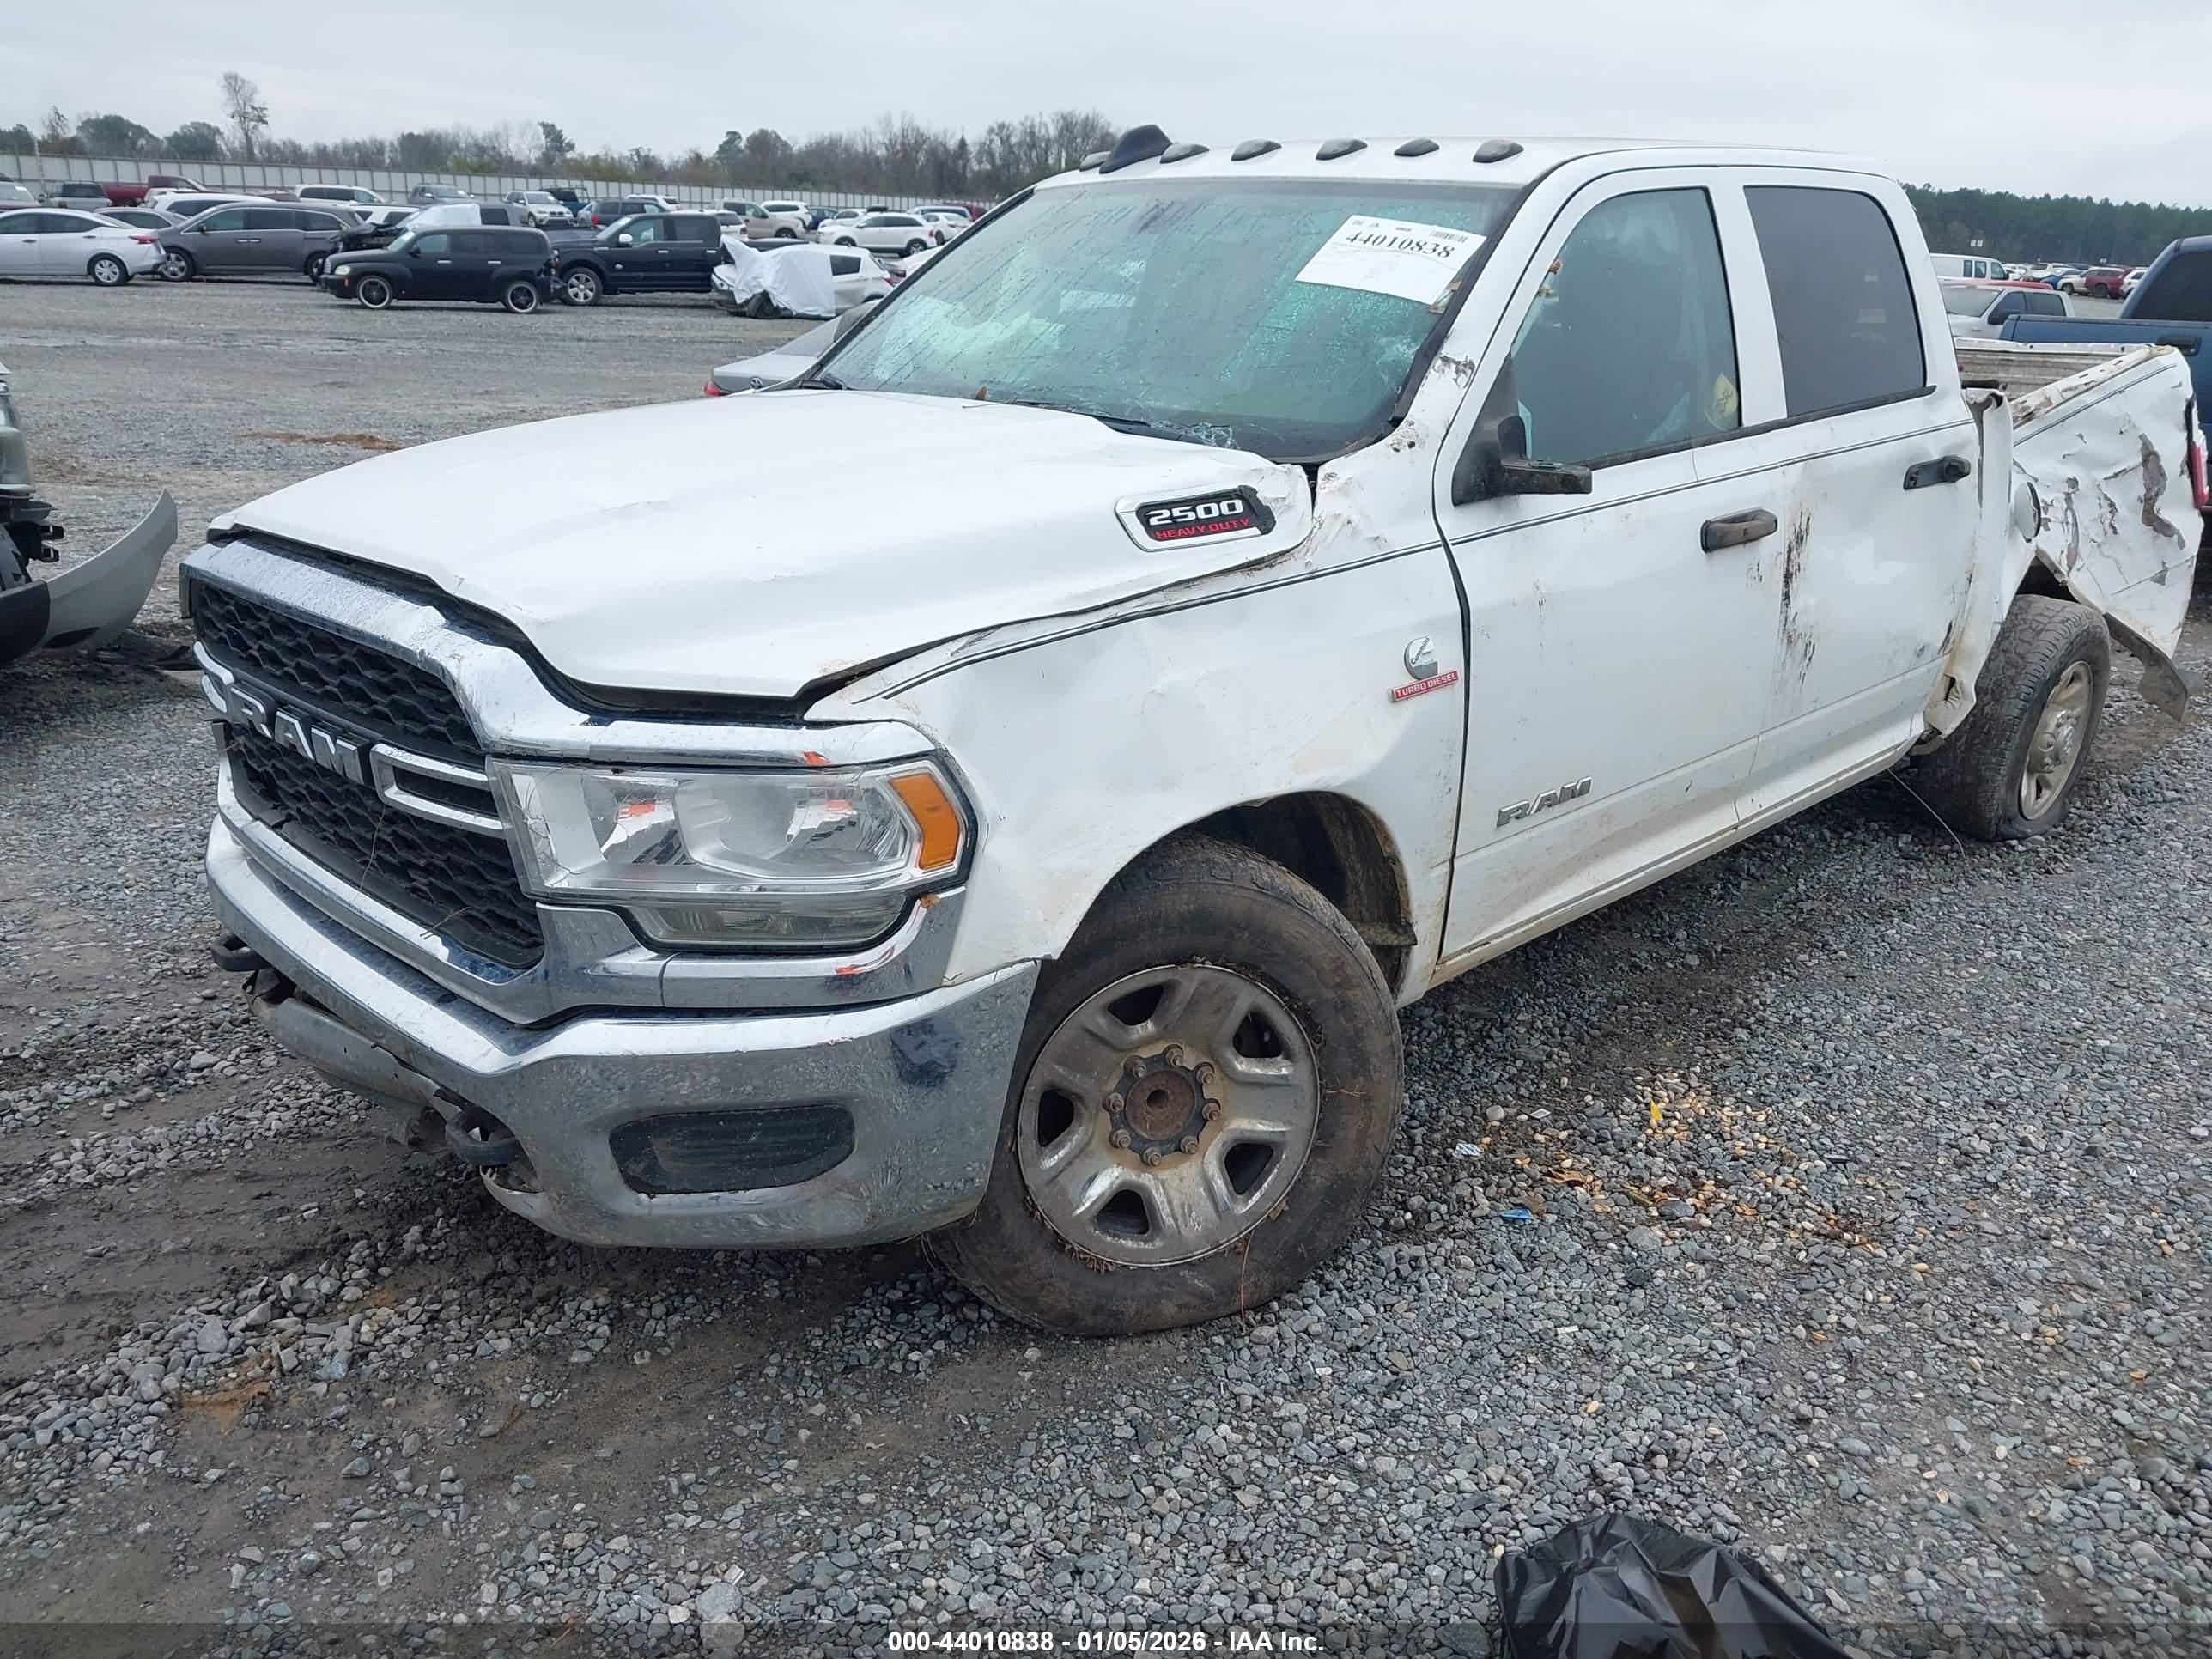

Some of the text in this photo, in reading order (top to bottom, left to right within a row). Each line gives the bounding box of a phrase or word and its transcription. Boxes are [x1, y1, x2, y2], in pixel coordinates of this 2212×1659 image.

[1346, 231, 1455, 258] 44010838
[1146, 500, 1244, 526] 2500
[1154, 518, 1251, 539] HEAVY DUTY
[1410, 635, 1431, 665] Cummins
[1395, 672, 1458, 697] TURBO DIESEL
[229, 684, 368, 786] RAM
[1496, 775, 1593, 828] RAM
